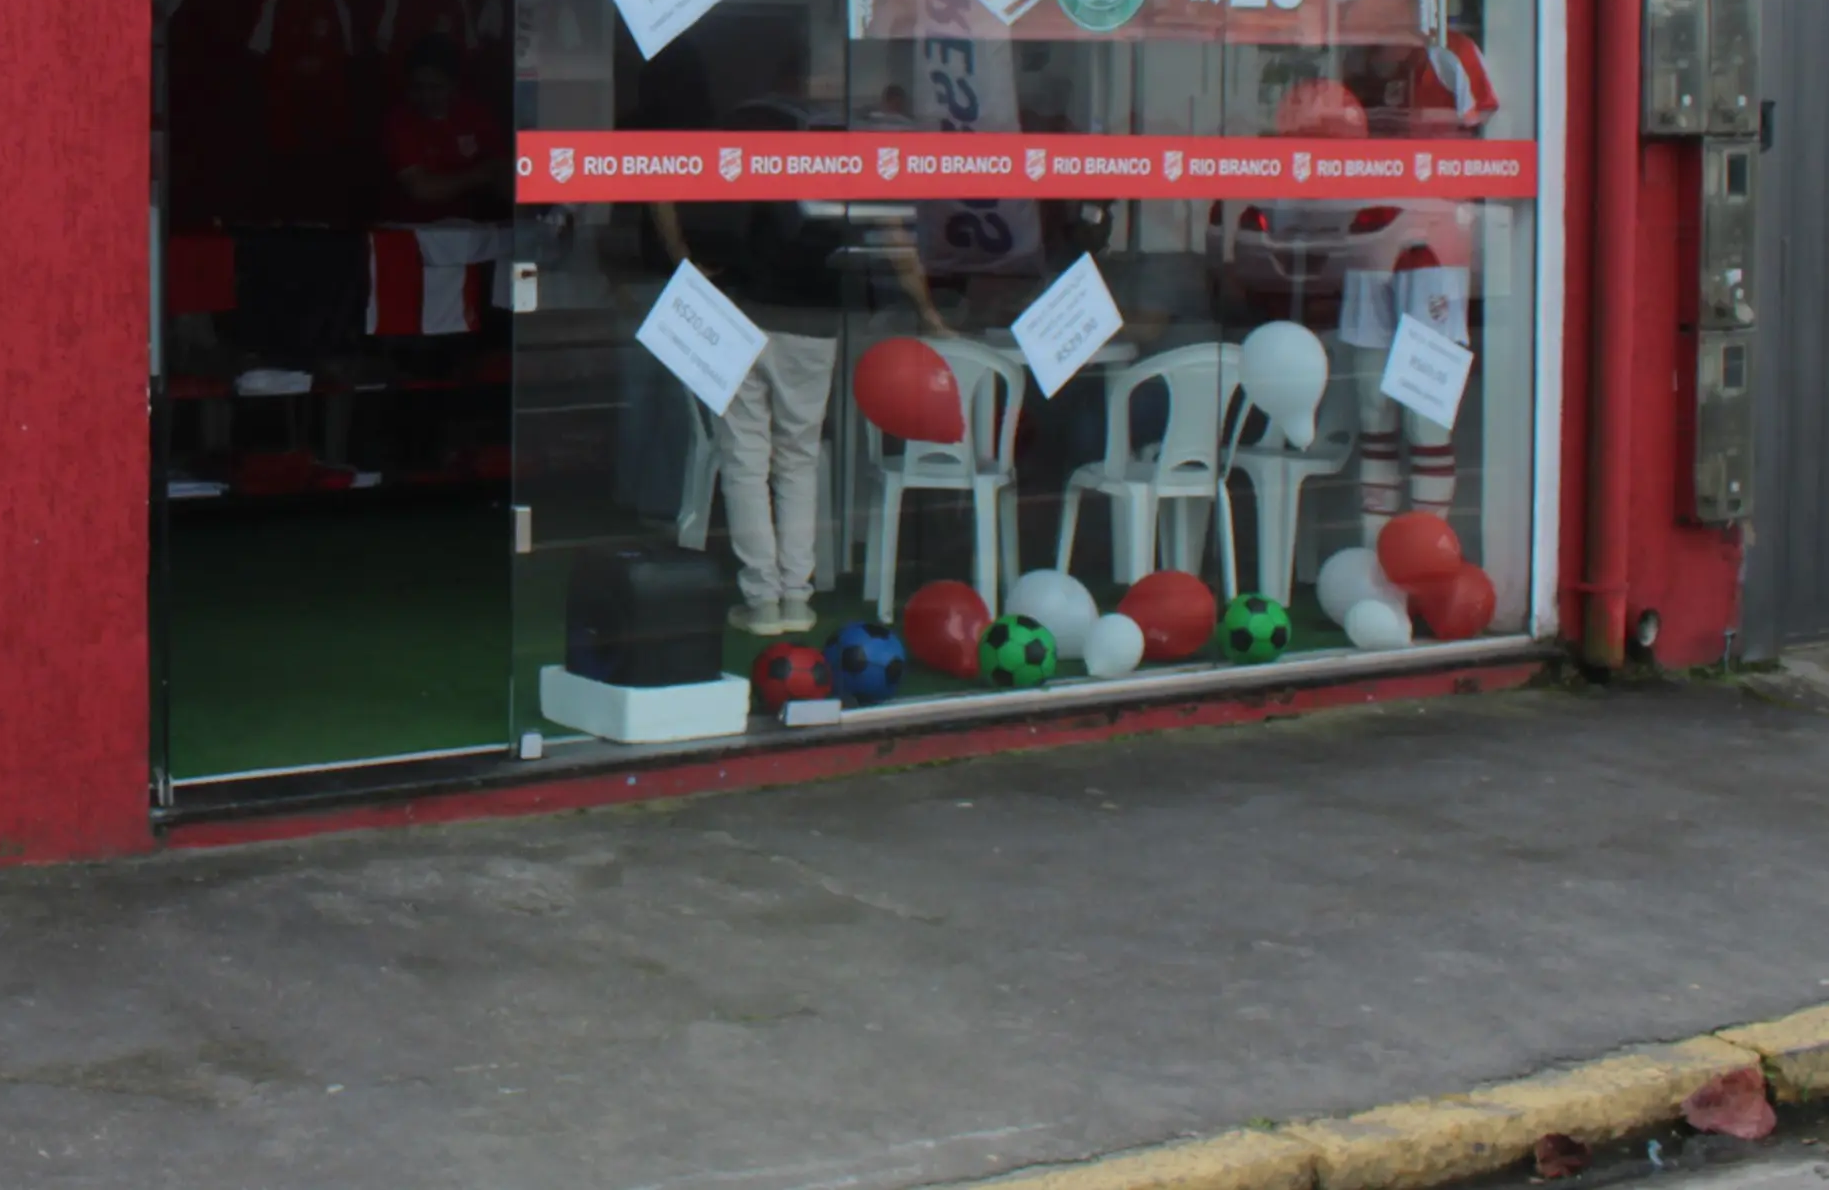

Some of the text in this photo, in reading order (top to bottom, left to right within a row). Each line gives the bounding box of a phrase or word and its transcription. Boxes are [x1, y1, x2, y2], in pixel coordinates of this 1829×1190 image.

[583, 156, 704, 176] RIO BRANCO
[750, 156, 862, 176] RIO BRANCO
[906, 156, 1012, 176] RIO BRANCO
[1052, 156, 1151, 176] RIO BRANCO
[1189, 158, 1281, 177] RIO BRANCO
[1317, 158, 1404, 177] RIO BRANCO
[1437, 158, 1520, 177] RIO BRANCO
